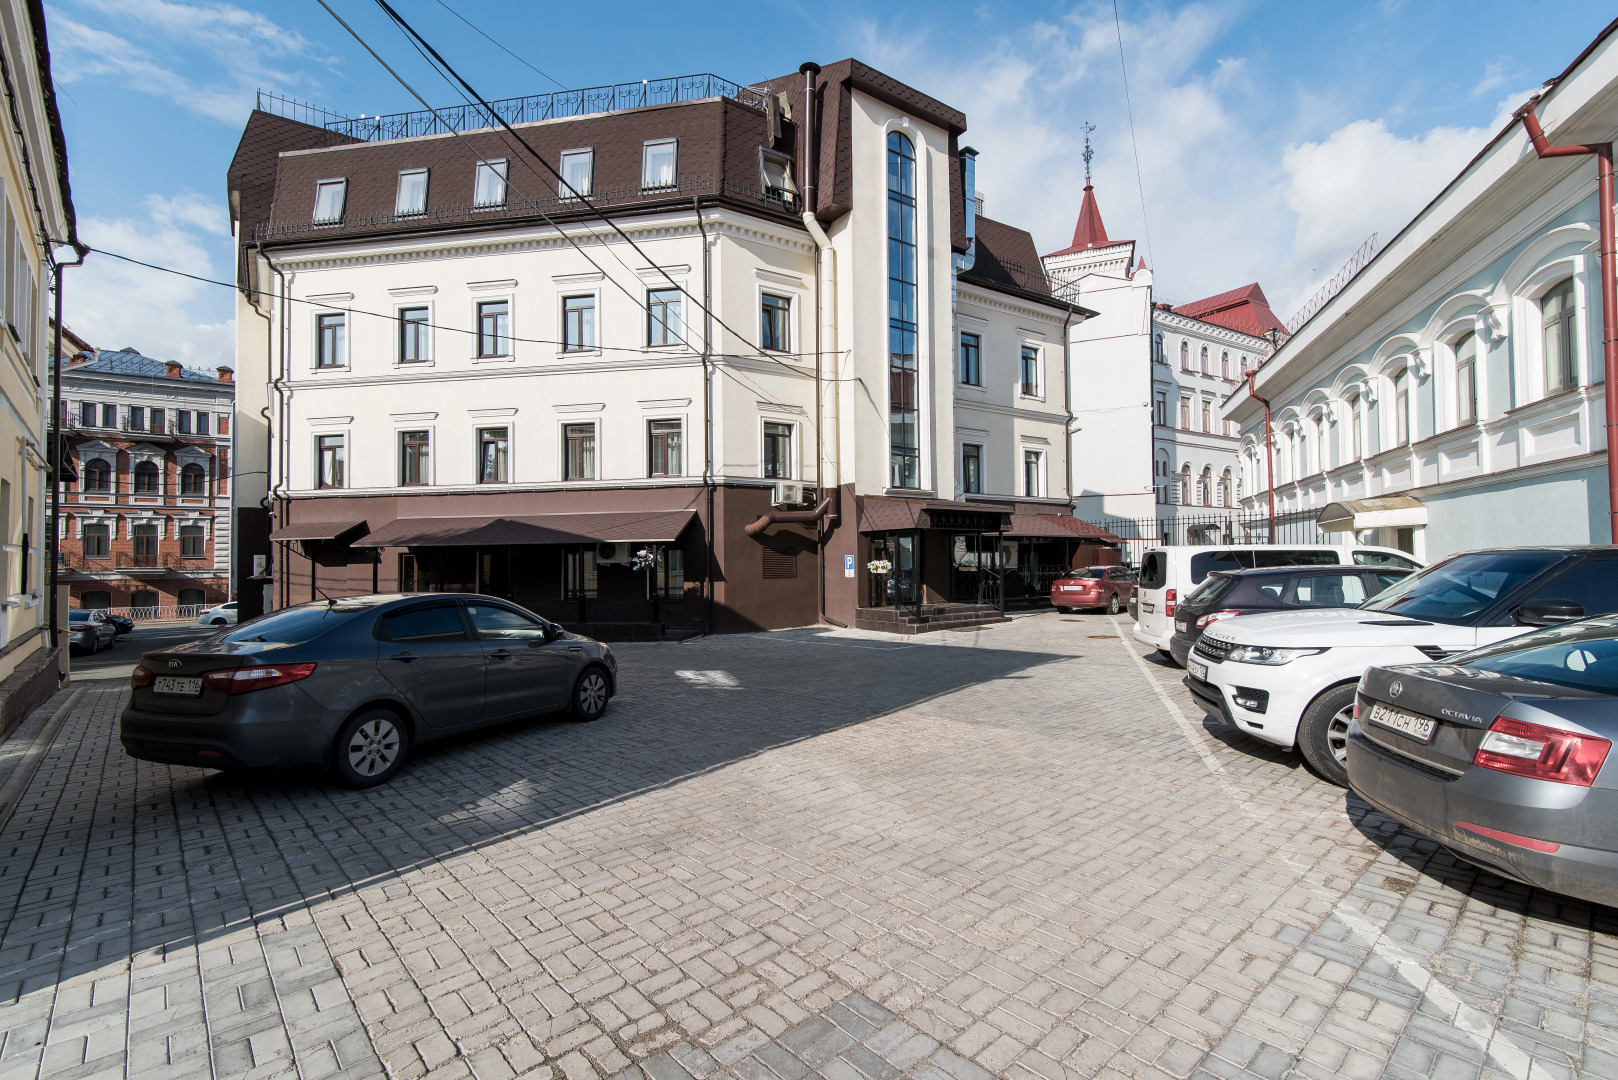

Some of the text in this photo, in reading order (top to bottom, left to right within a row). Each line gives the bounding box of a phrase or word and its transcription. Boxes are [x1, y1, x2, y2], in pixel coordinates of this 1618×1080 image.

[847, 557, 852, 568] P
[1414, 716, 1430, 732] 196
[1441, 708, 1483, 724] OCTAVIA
